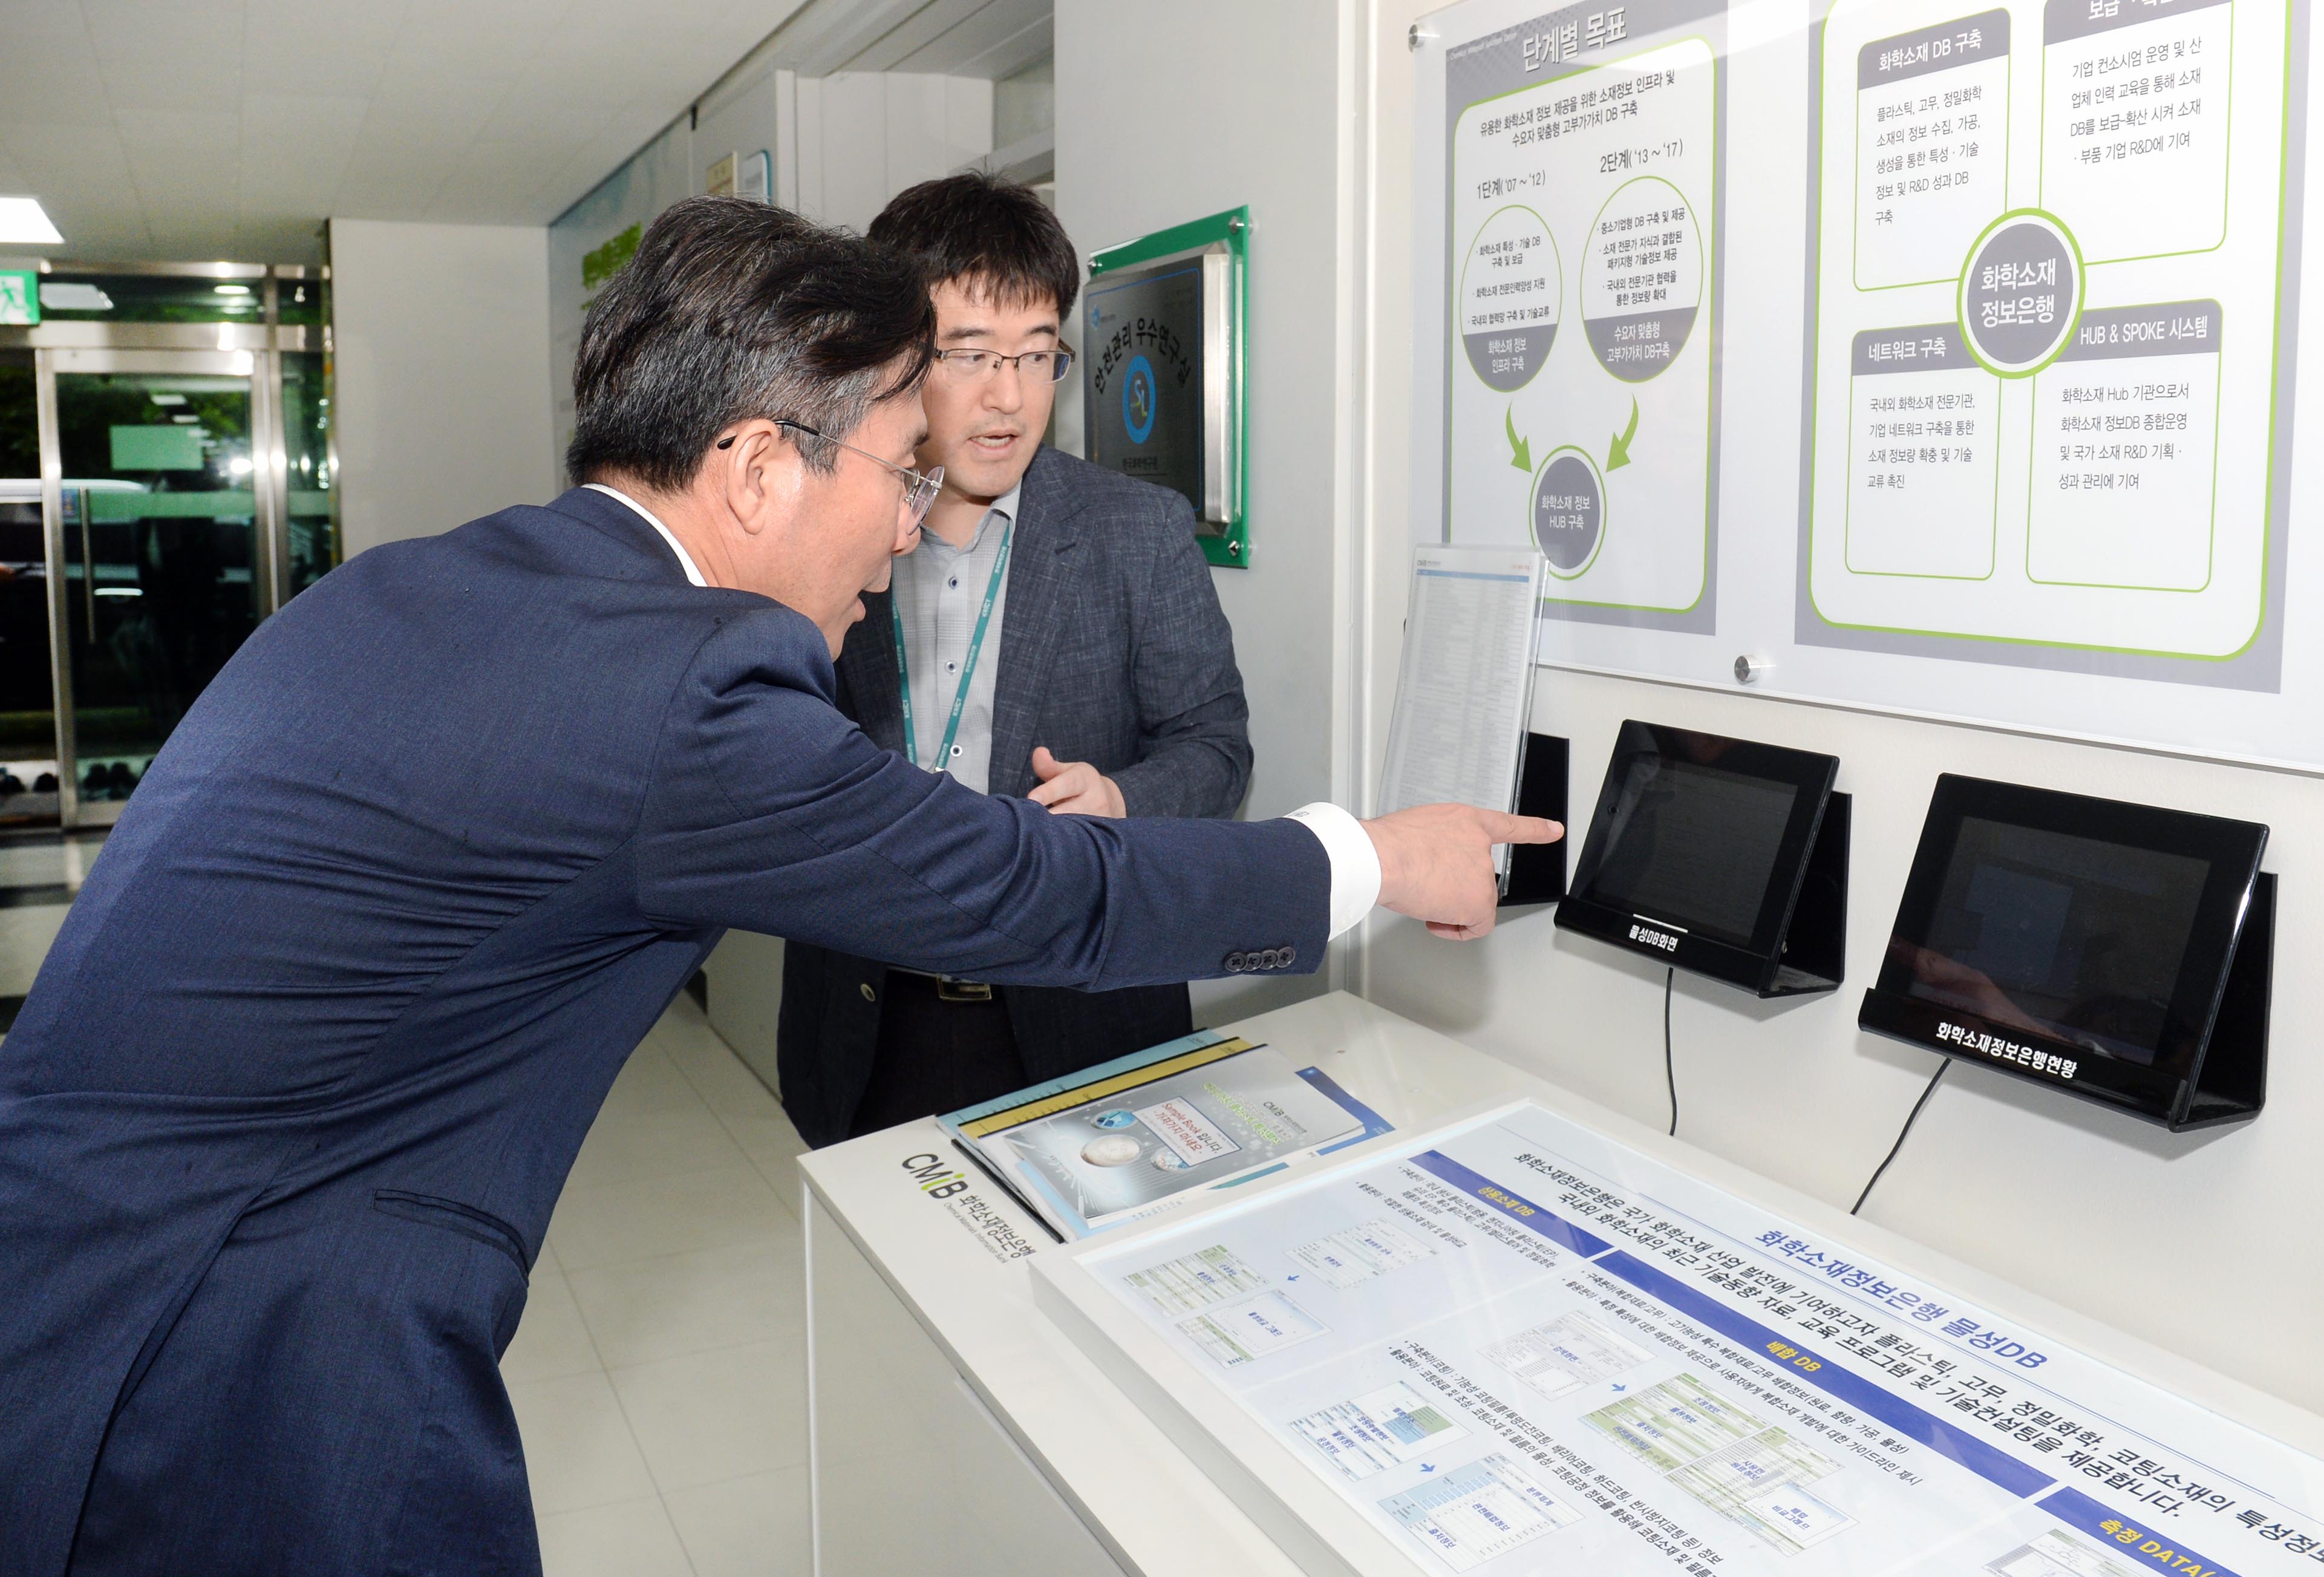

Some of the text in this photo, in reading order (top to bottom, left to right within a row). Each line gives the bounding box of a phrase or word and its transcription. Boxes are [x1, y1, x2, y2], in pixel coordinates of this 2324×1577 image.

[1523, 20, 1578, 73] 단계별
[1586, 7, 1627, 49] 목표
[1879, 28, 1982, 71] 화학소재 DB 구축
[2072, 36, 2201, 78] 기업 컨소시엄 운영 및 산
[2071, 67, 2200, 108] 업체 인력 교육을 통해 소재
[1480, 70, 1674, 137] 유용한 화학소재 정보 제공을 위한 소재정보 인프라 및
[1877, 85, 1982, 122] 플라스틱, 고무, 정밀화학
[2071, 98, 2200, 136] DB를 보급-확산 시켜 소재
[1512, 99, 1637, 147] 수요자 맞춤형 고부가가치 DB 구축
[1876, 114, 1980, 146] 소재의 정보 수집, 가공,
[1876, 141, 1979, 174] 생성을 통한 특성 기술
[1875, 171, 1968, 200] 정보 및 R&D 성과 DB
[1601, 207, 1685, 234] 중소기업형 DB 구축 및 제공
[1981, 258, 2055, 292] 화학소재
[1980, 294, 2054, 328] 정보은행
[1613, 321, 1660, 342] 수요자 맞춤형
[2080, 315, 2207, 345] HUB & SPOKE 시스템
[1607, 341, 1670, 362] 고부가가치 DB구축
[1869, 336, 1947, 362] 네트워크 구축
[1870, 393, 1974, 412] 국내외 화학소재 전문기관,
[2061, 382, 2189, 403] 화학소재 Hub 기관으로서
[1869, 420, 1974, 437] 기업 네트워크 구축을 통한
[2060, 413, 2187, 432] 화학소재 정보DB 종합운영
[1867, 447, 1972, 463] 소재 정보량 확충 및 기술
[2060, 443, 2173, 460] 및 국가 소재 R&D 기획
[1541, 495, 1590, 511] 화학소재 정보
[1549, 514, 1584, 530] HUB 구축
[1629, 924, 1679, 952] 물성DB화면
[1936, 1022, 2077, 1079] 화학소재정보은행현황
[1162, 1102, 1223, 1154] Sample Book 입니다.
[902, 1154, 1037, 1259] CMiB 화학소재정보은행
[1478, 1187, 1535, 1216] 상용소재 DB
[1755, 1230, 2047, 1368] 화학소재정보은행 물성DB
[1514, 1154, 1625, 1209] 화학소재정보은행은
[1622, 1206, 1655, 1224] 국가
[1649, 1221, 1714, 1253] 화학소재
[1706, 1250, 1746, 1269] 산업
[1738, 1266, 1796, 1294] 발전에
[1789, 1291, 1880, 1336] 기여하고자
[1873, 1333, 1957, 1377] 플라스틱,
[1957, 1375, 2007, 1403] 고무,
[2011, 1400, 2104, 1451] 정밀화학,
[2107, 1448, 2236, 1512] 코팅소재의
[1558, 1193, 2184, 1517] 국내외 화학소재의 최근 기술동향 자료, 교육 프로그램 및 기술컨설팅을 제공합니다.
[1766, 1341, 1821, 1371] 배합 DB
[2100, 1520, 2143, 1544] 측정
